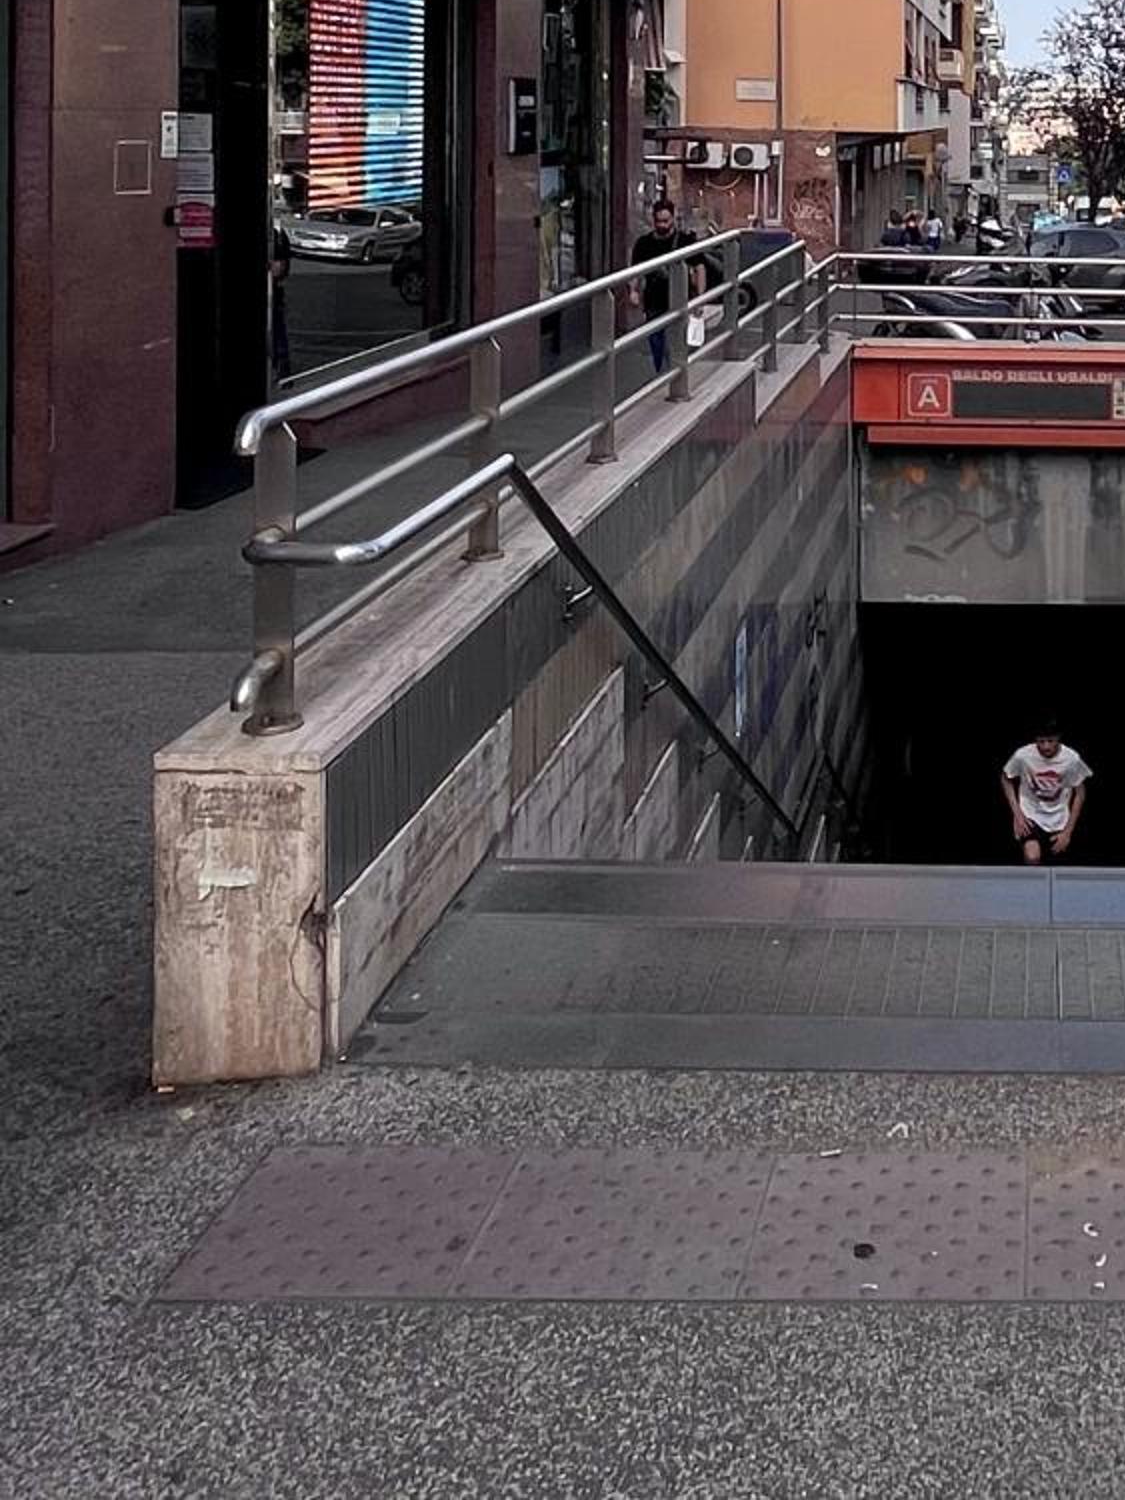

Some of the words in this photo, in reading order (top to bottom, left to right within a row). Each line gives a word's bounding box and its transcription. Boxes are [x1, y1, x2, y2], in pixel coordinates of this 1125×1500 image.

[917, 384, 940, 408] A
[952, 369, 1001, 381] BALDO
[1057, 372, 1113, 383] UBALDI
